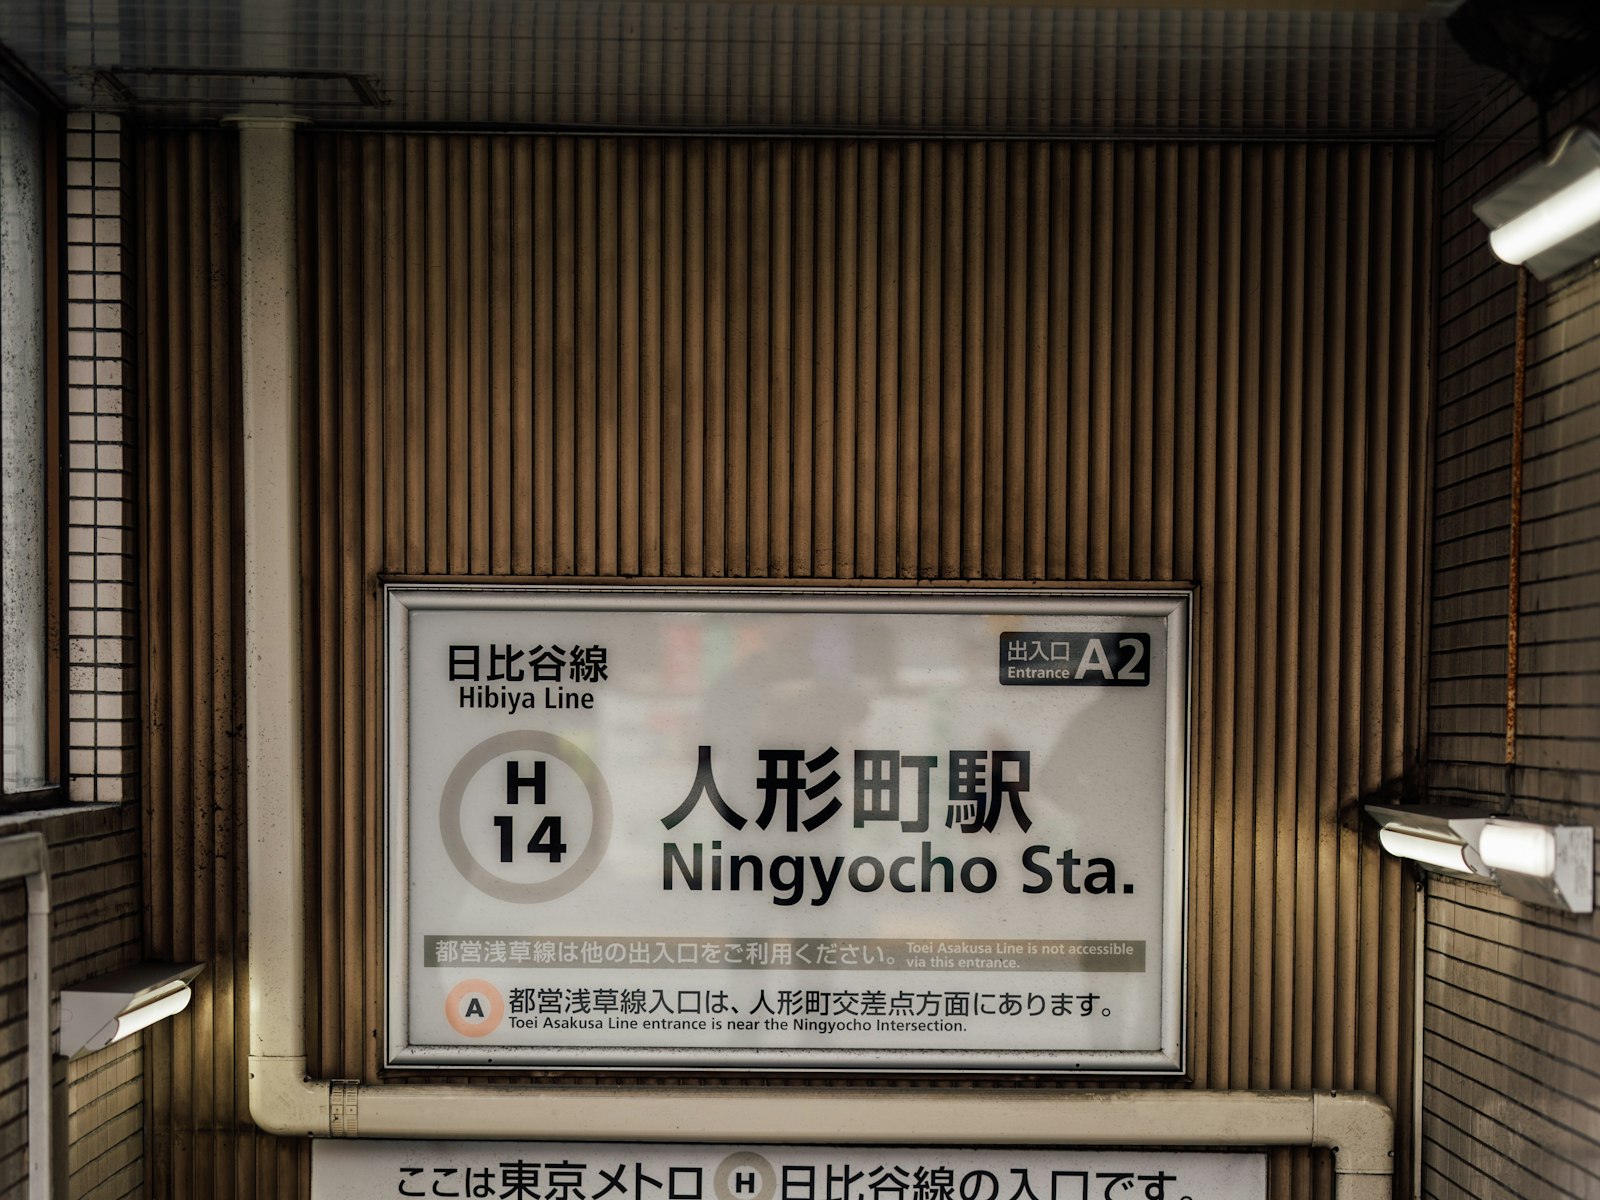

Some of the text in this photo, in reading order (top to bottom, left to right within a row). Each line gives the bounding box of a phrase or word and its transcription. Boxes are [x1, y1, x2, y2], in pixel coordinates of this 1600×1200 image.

[448, 644, 609, 683] 日比谷線
[1007, 640, 1070, 662] 出入口
[1073, 638, 1146, 680] A2
[1007, 666, 1070, 680] Entrance
[458, 685, 595, 714] Hibiya Line
[506, 760, 546, 805] H
[660, 745, 1033, 834] 人形町駅
[493, 816, 567, 863] 14
[662, 841, 1134, 907] Ningyocho Sta.
[435, 940, 896, 967] 都営浅草線は他の出入口をご利用ください。
[906, 942, 1134, 957] Toei Asakusa Line is not accessible
[906, 957, 1021, 970] via this entrance.
[465, 998, 485, 1017] A
[509, 988, 1111, 1017] 都営浅草線入口は、人形町交差点方面にあります。
[509, 1016, 967, 1035] Toei Asakusa Line entrance is near the Ningyocho Intersection.
